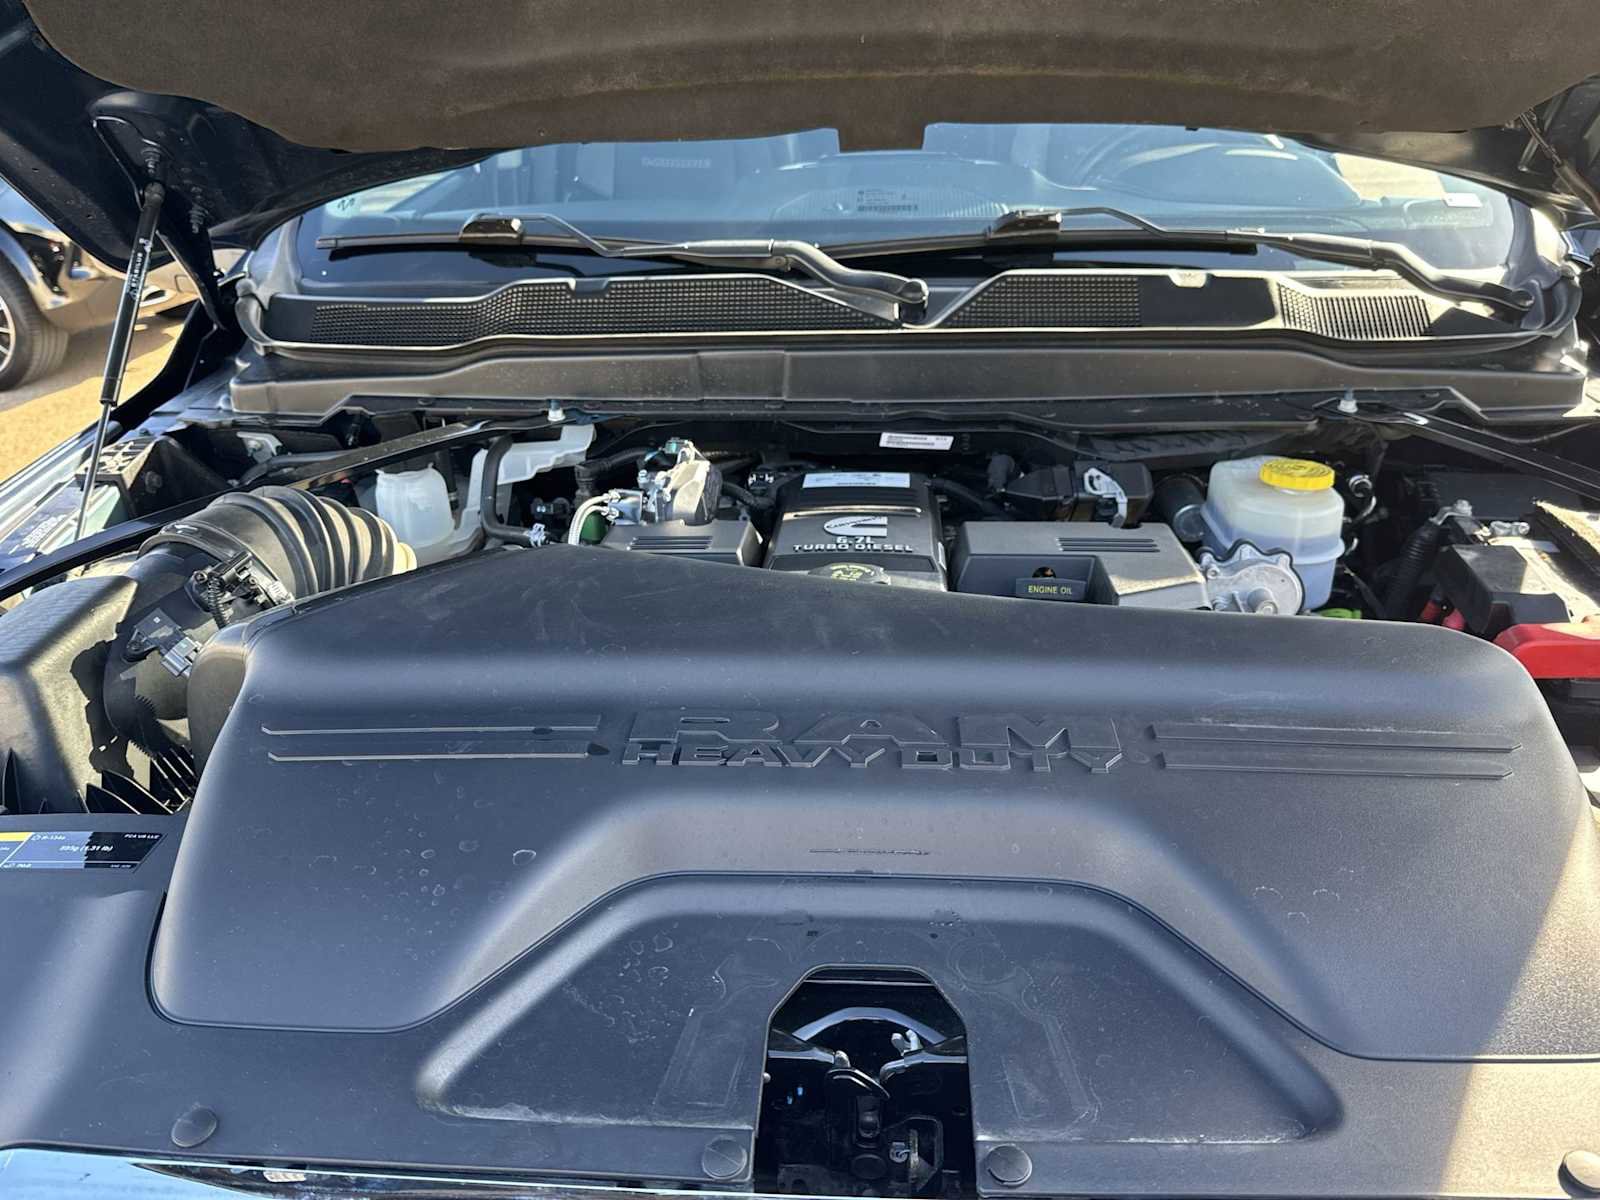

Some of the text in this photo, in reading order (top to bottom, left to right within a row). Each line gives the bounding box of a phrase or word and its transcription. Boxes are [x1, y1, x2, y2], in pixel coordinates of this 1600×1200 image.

[836, 536, 875, 545] 6.7L
[793, 543, 914, 553] TURBO DIESEL
[1027, 584, 1073, 595] ENGINE OIL
[628, 708, 1122, 749] RAM
[622, 742, 1123, 773] HEAVY DUTY
